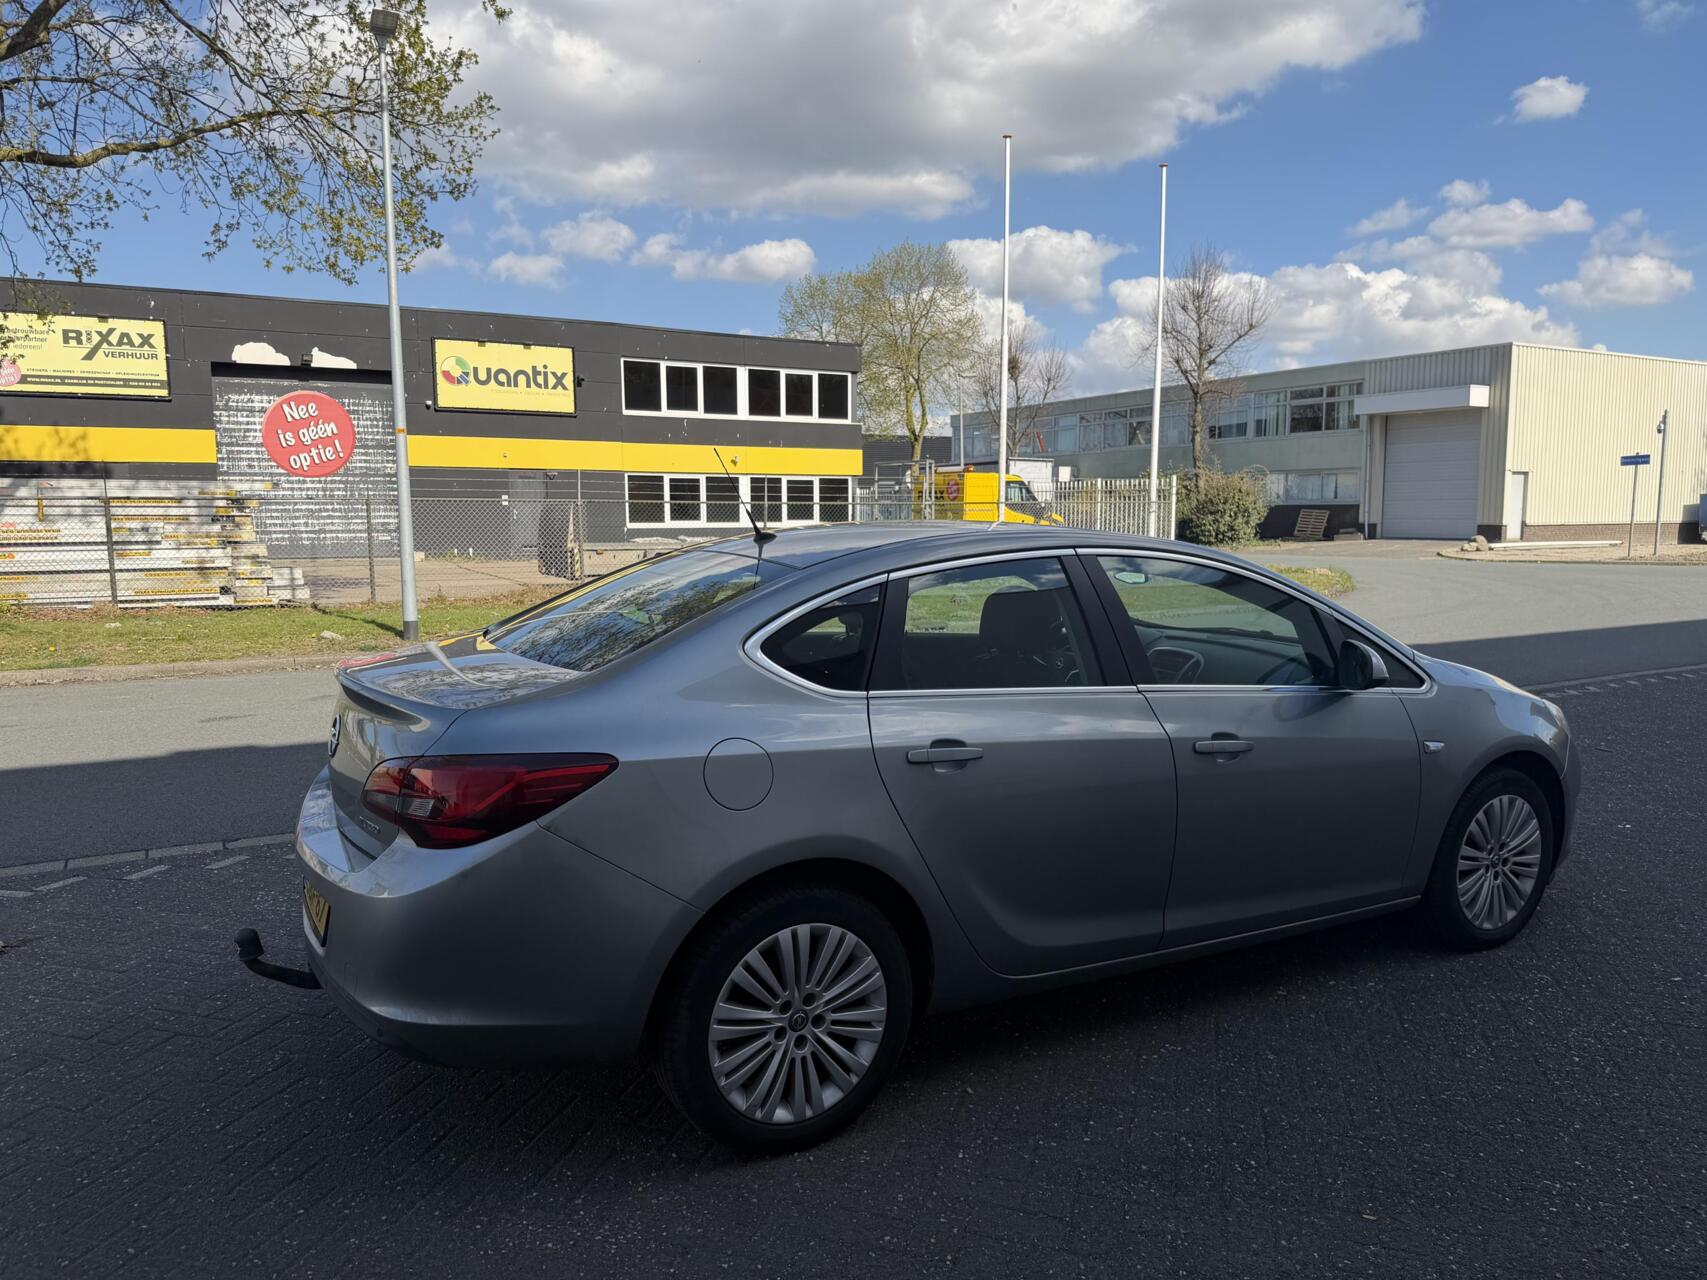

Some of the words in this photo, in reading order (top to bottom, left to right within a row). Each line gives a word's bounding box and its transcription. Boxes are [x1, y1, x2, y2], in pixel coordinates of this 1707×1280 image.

[103, 350, 158, 360] VERHUUR
[281, 401, 319, 423] Nee
[276, 428, 297, 448] is
[297, 418, 339, 446] géén
[288, 439, 344, 472] optie!
